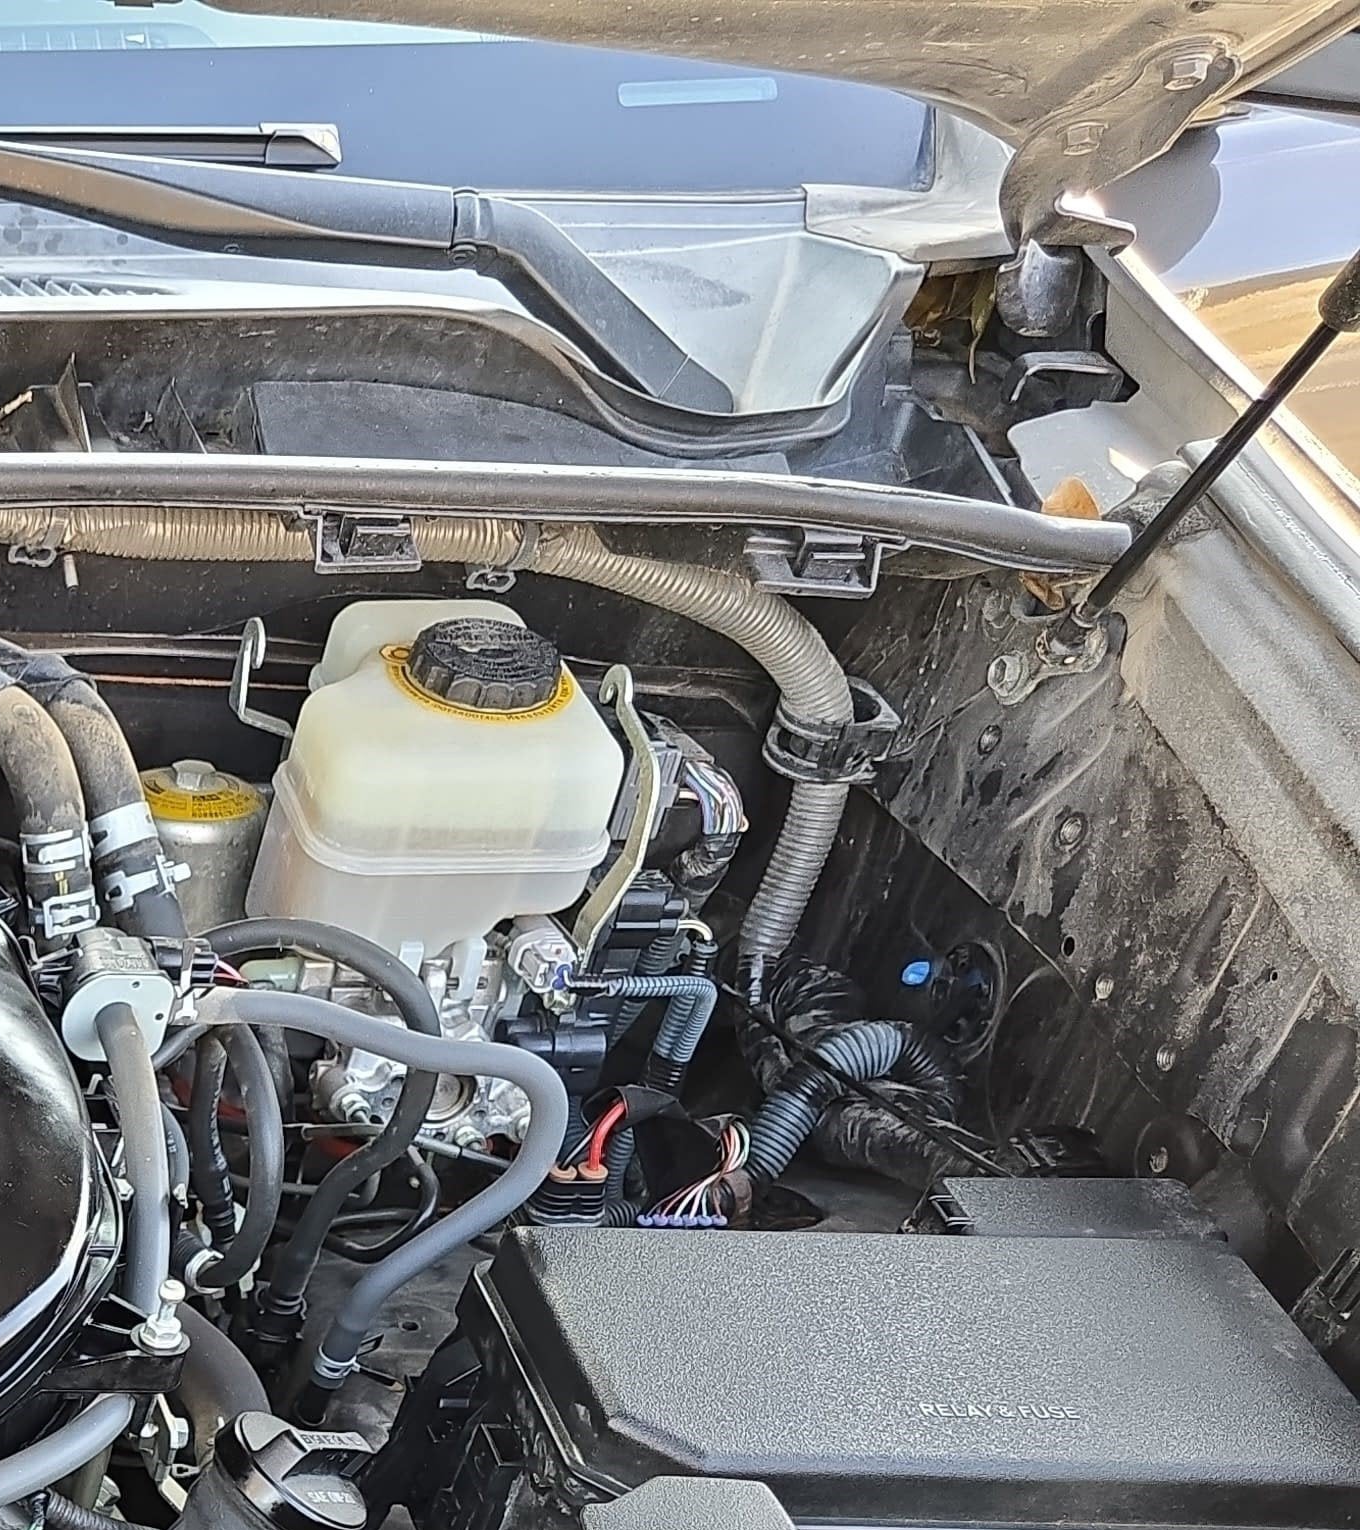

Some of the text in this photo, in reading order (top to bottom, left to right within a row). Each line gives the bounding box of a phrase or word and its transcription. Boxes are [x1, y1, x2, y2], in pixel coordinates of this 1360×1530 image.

[918, 1402, 1081, 1420] RELAY & FUSE
